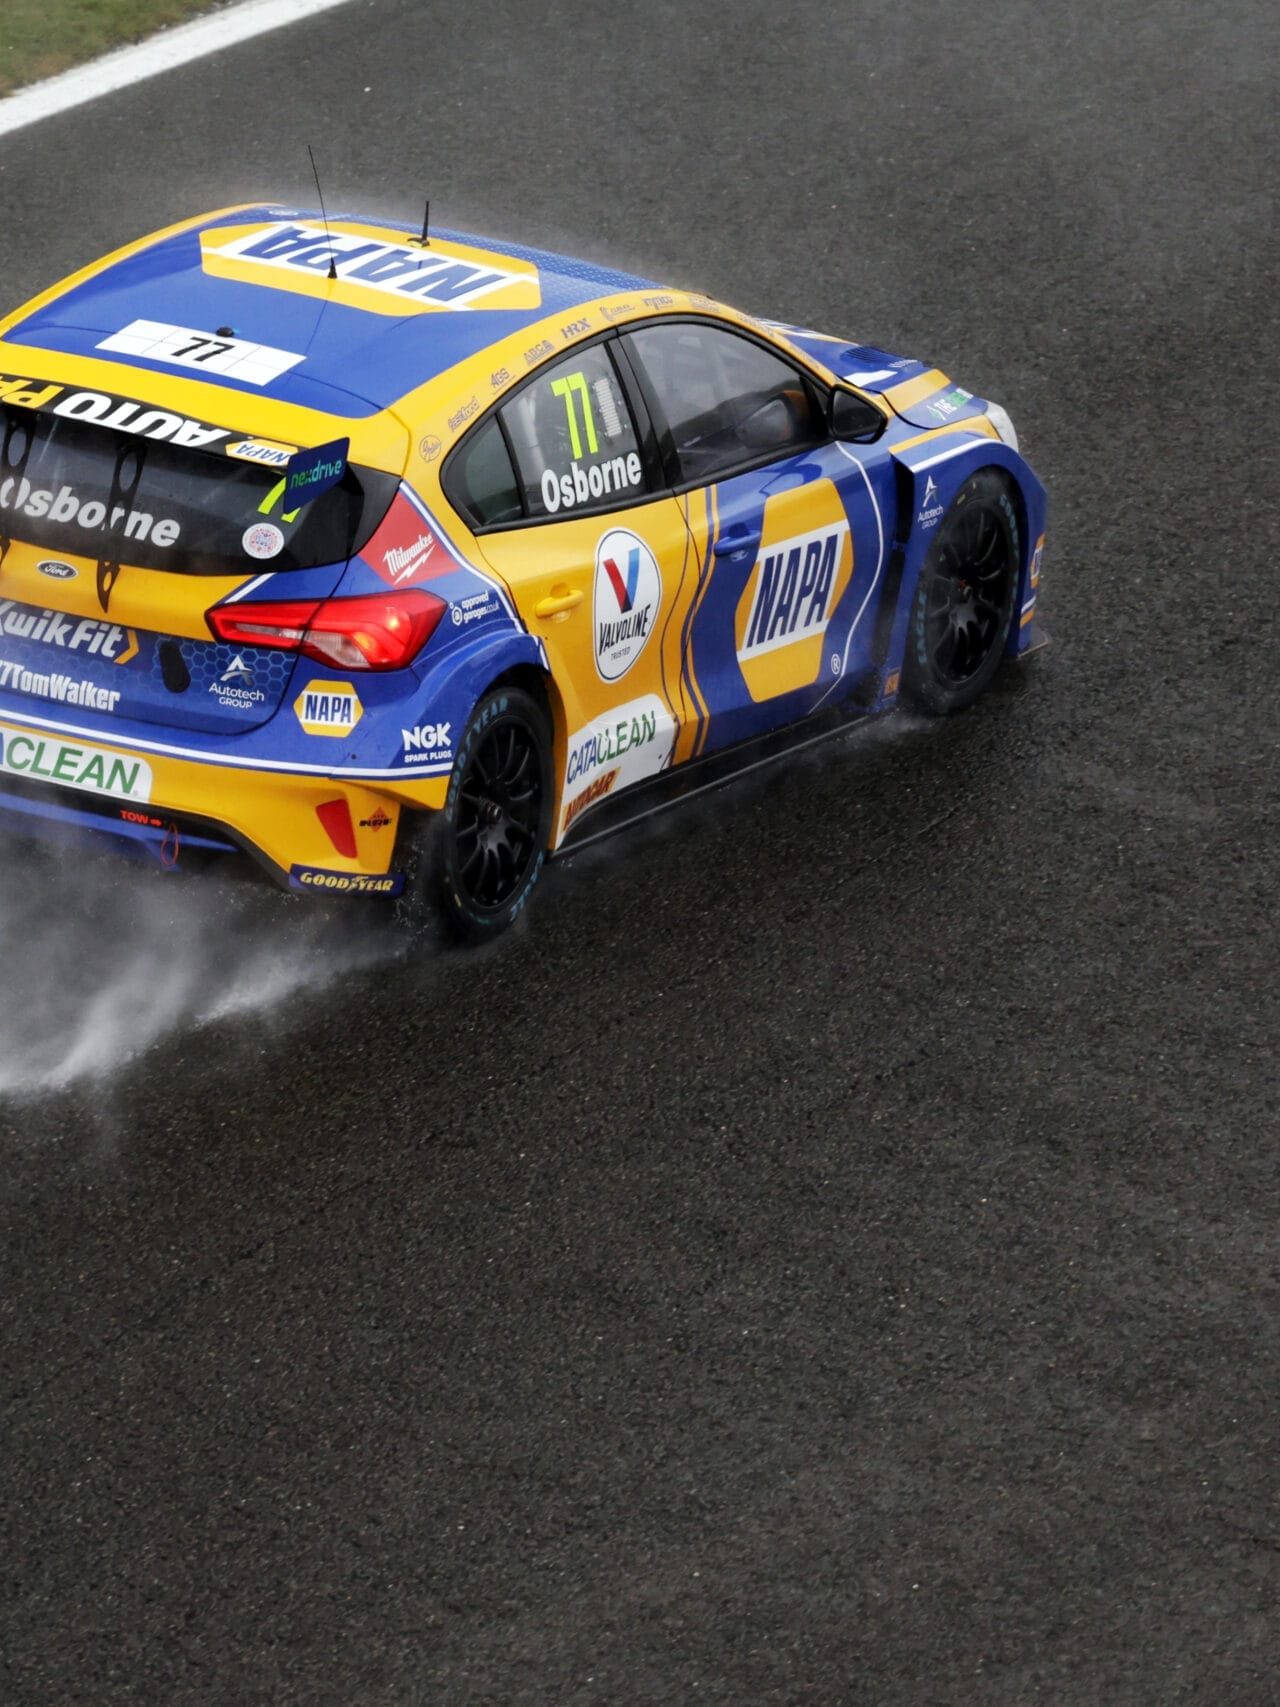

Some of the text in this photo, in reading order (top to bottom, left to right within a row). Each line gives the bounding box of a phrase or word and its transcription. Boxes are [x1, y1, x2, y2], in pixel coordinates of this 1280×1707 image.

[237, 225, 508, 303] NAPA
[170, 336, 236, 362] 77
[52, 391, 233, 448] AUTO
[550, 371, 599, 460] 77
[235, 443, 292, 464] NAPA
[540, 452, 642, 513] Osborne
[917, 505, 944, 522] Autotech
[382, 532, 434, 576] Milwaukee
[44, 563, 68, 577] Ford
[747, 534, 839, 649] NAPA
[599, 603, 651, 656] VALVOLINE
[208, 684, 265, 702] Autotech
[218, 696, 253, 708] GROUP
[304, 695, 353, 723] NAPA
[401, 722, 452, 751] NGK
[567, 710, 656, 784] CATACLEAN
[404, 750, 452, 763] SPARK PLUGS
[120, 810, 149, 825] TOW
[299, 871, 394, 893] GOODYEAR
